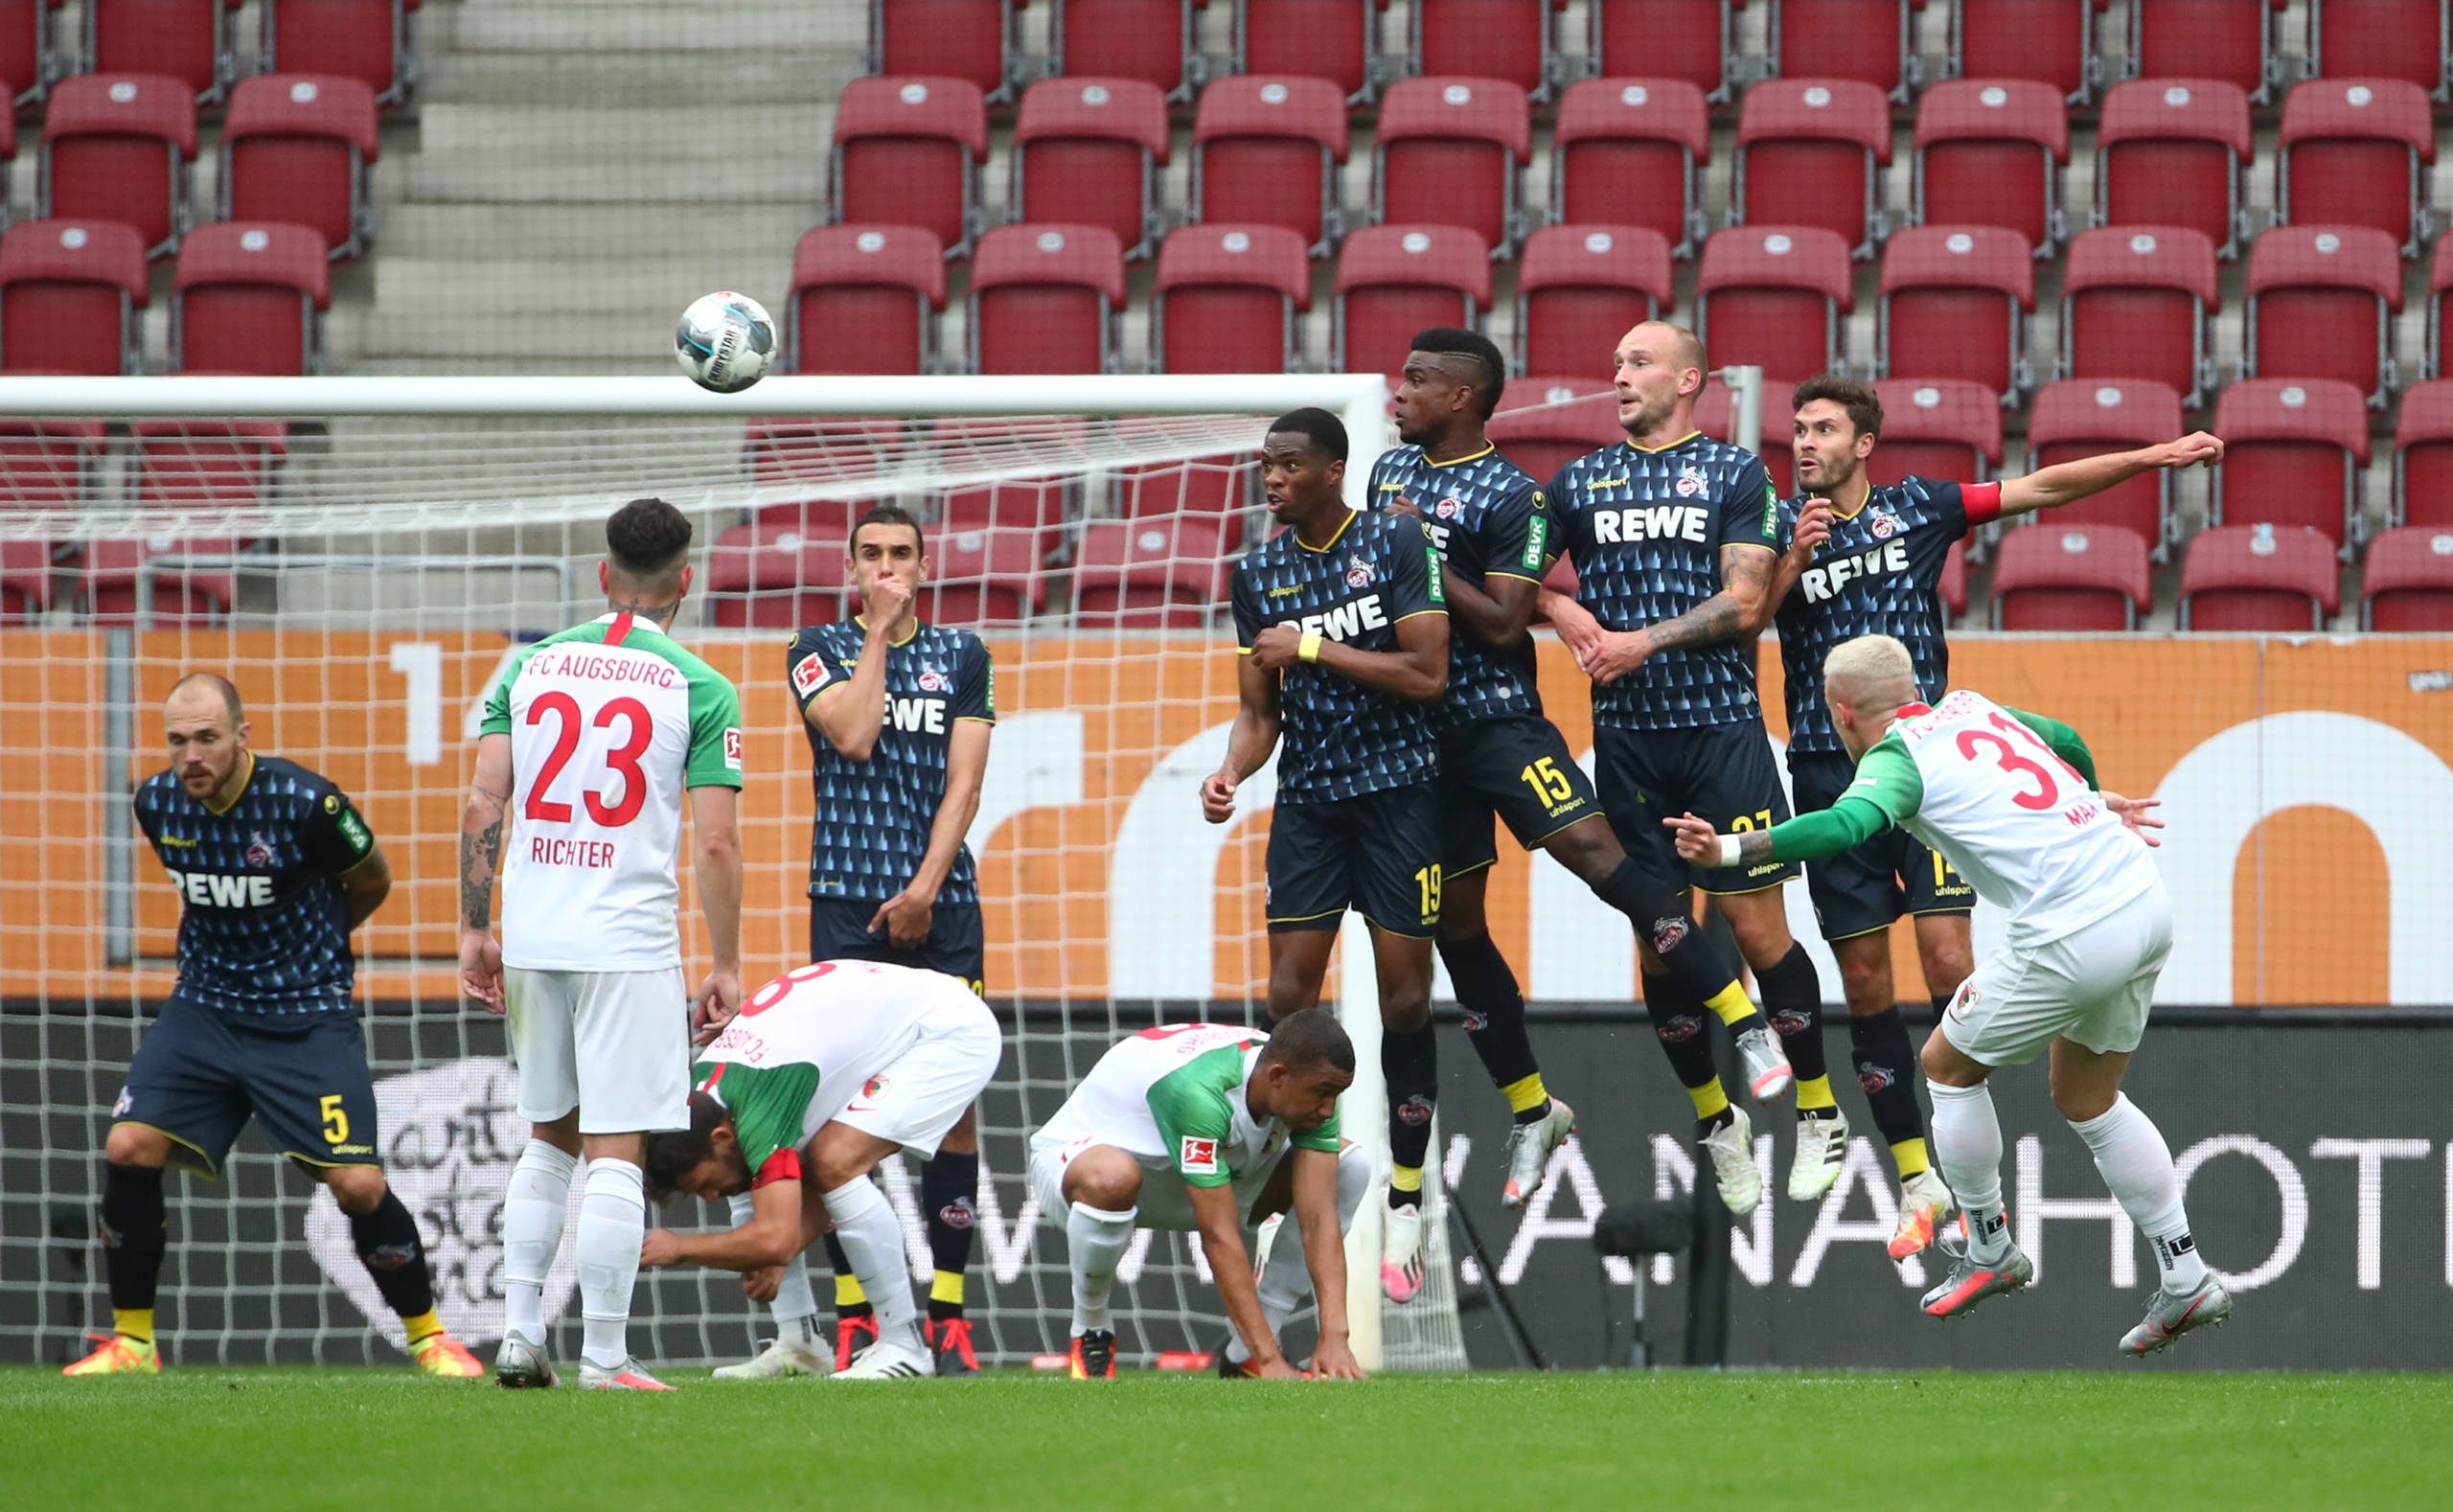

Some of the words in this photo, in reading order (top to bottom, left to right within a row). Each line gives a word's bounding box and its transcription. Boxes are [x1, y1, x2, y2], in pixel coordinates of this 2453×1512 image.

[1586, 477, 1629, 492] uhlsport
[1593, 505, 1709, 545] REWE
[1766, 491, 1777, 535] DEVK
[1527, 521, 1544, 566] DEVK
[1269, 583, 1305, 599] uhlsport
[1431, 552, 1442, 598] DEVK
[1800, 537, 1911, 606] REWE
[529, 654, 555, 676] FC
[558, 654, 676, 689] AUGSBURG
[525, 690, 654, 828] 23
[1956, 711, 2084, 811] 31
[1521, 756, 1573, 810] 15
[1549, 796, 1586, 818] uhlsport
[532, 836, 616, 869] RICHTER
[1415, 863, 1442, 917] 19
[740, 961, 837, 1019] 8
[319, 1094, 350, 1145] 5
